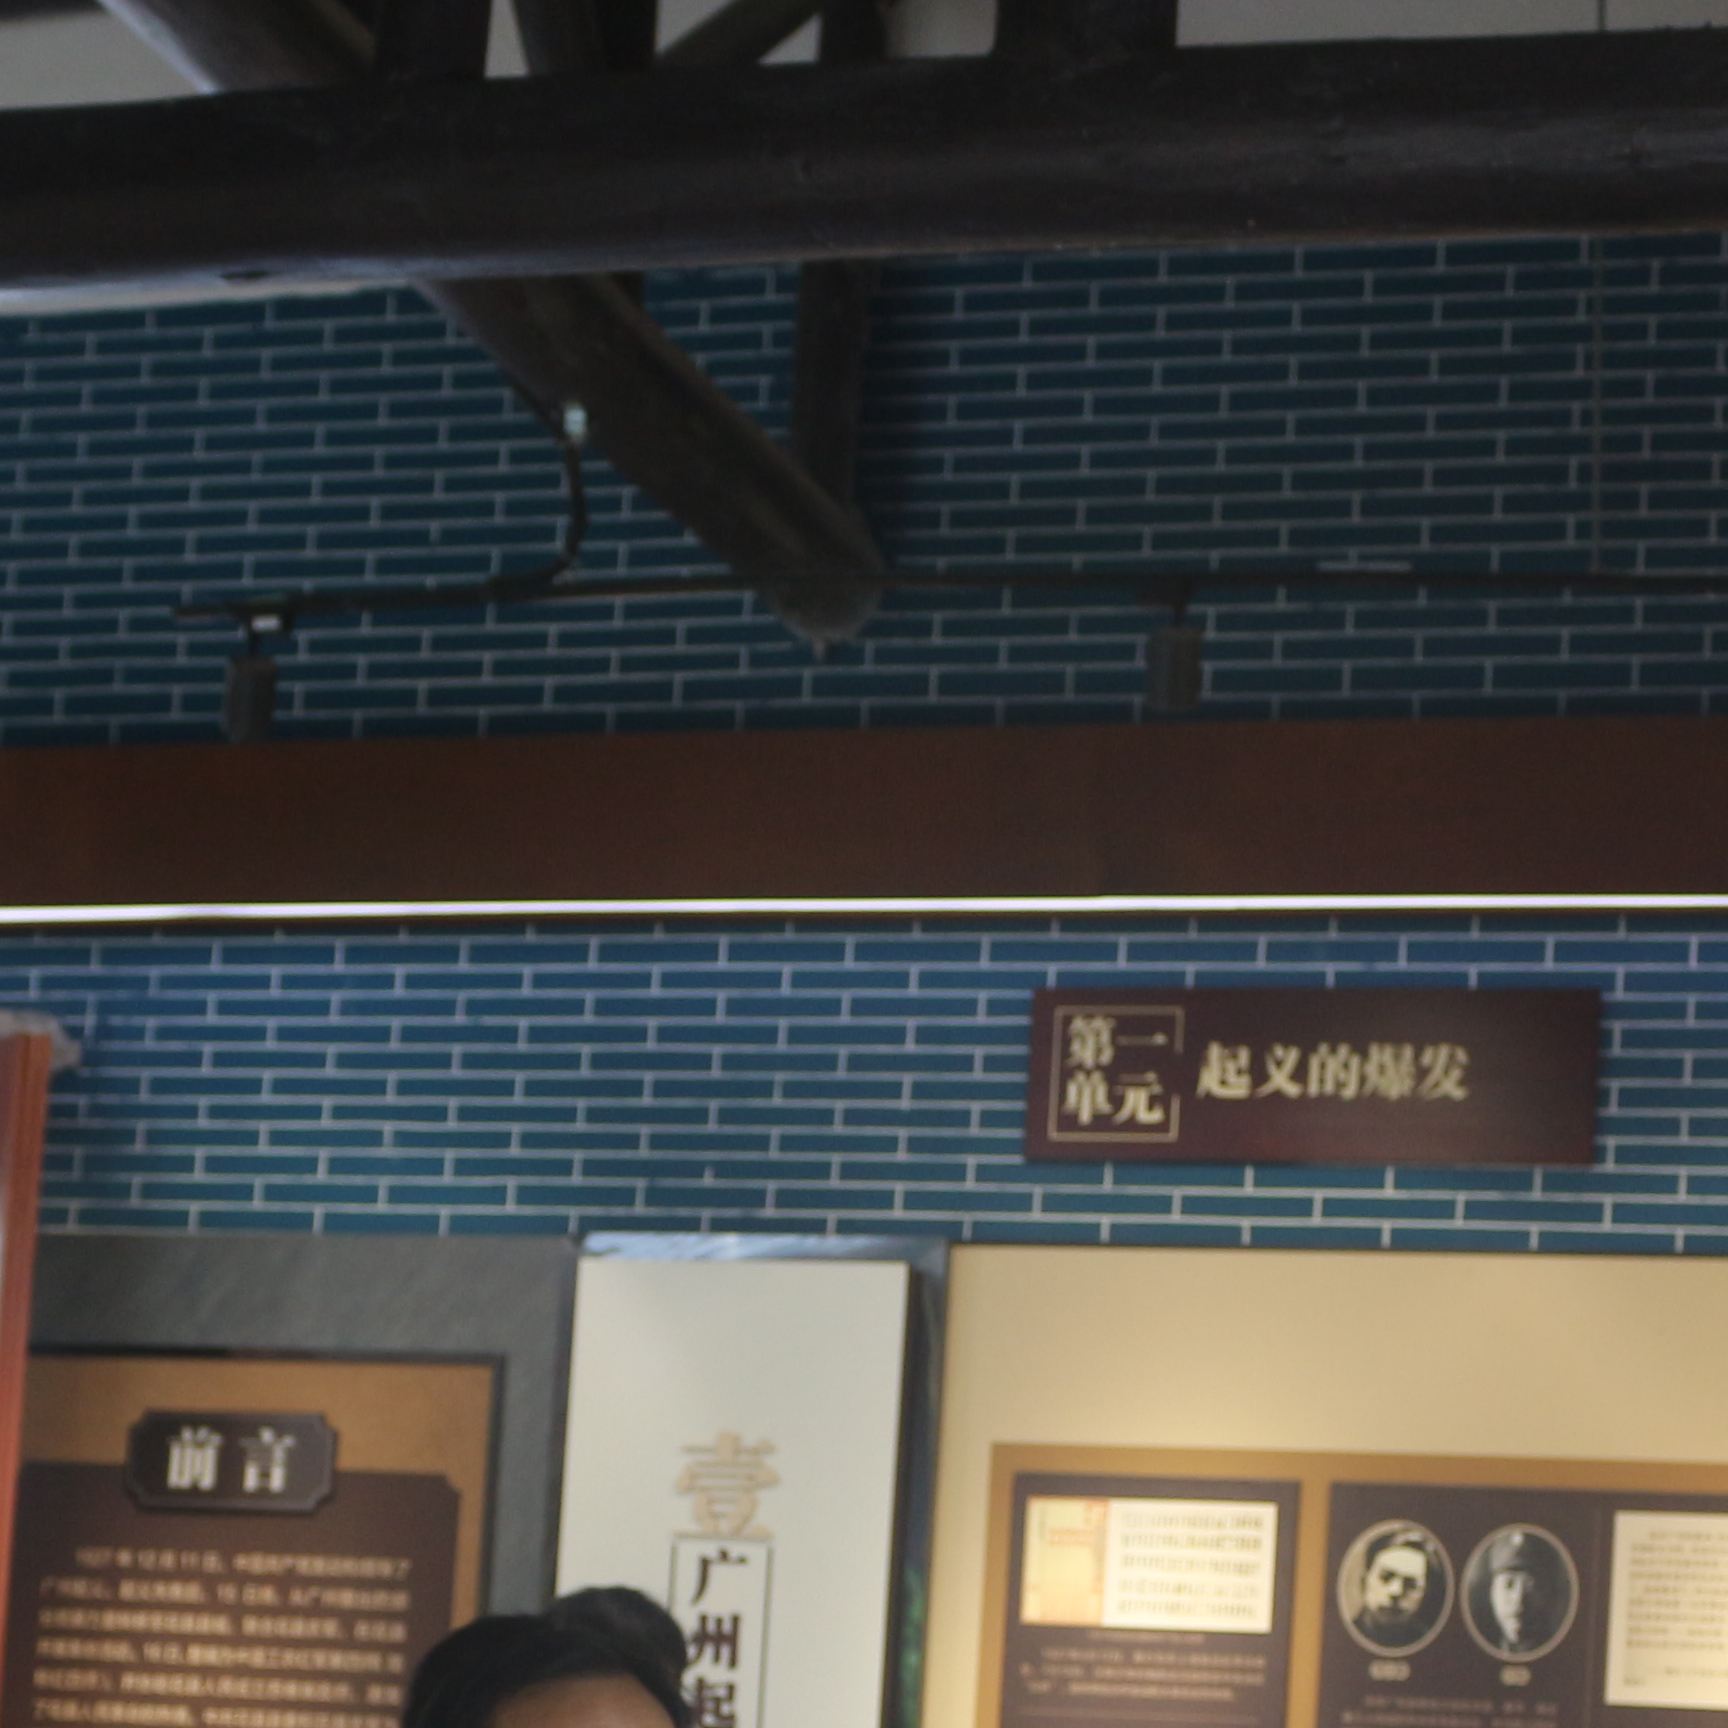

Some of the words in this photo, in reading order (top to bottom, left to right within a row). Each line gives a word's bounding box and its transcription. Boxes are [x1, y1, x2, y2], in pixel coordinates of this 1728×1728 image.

[1065, 1015, 1170, 1070] 第一
[1195, 1041, 1473, 1103] 起义的爆发
[1060, 1071, 1166, 1127] 单元
[166, 1426, 297, 1493] 前言
[674, 1430, 781, 1538] 壹
